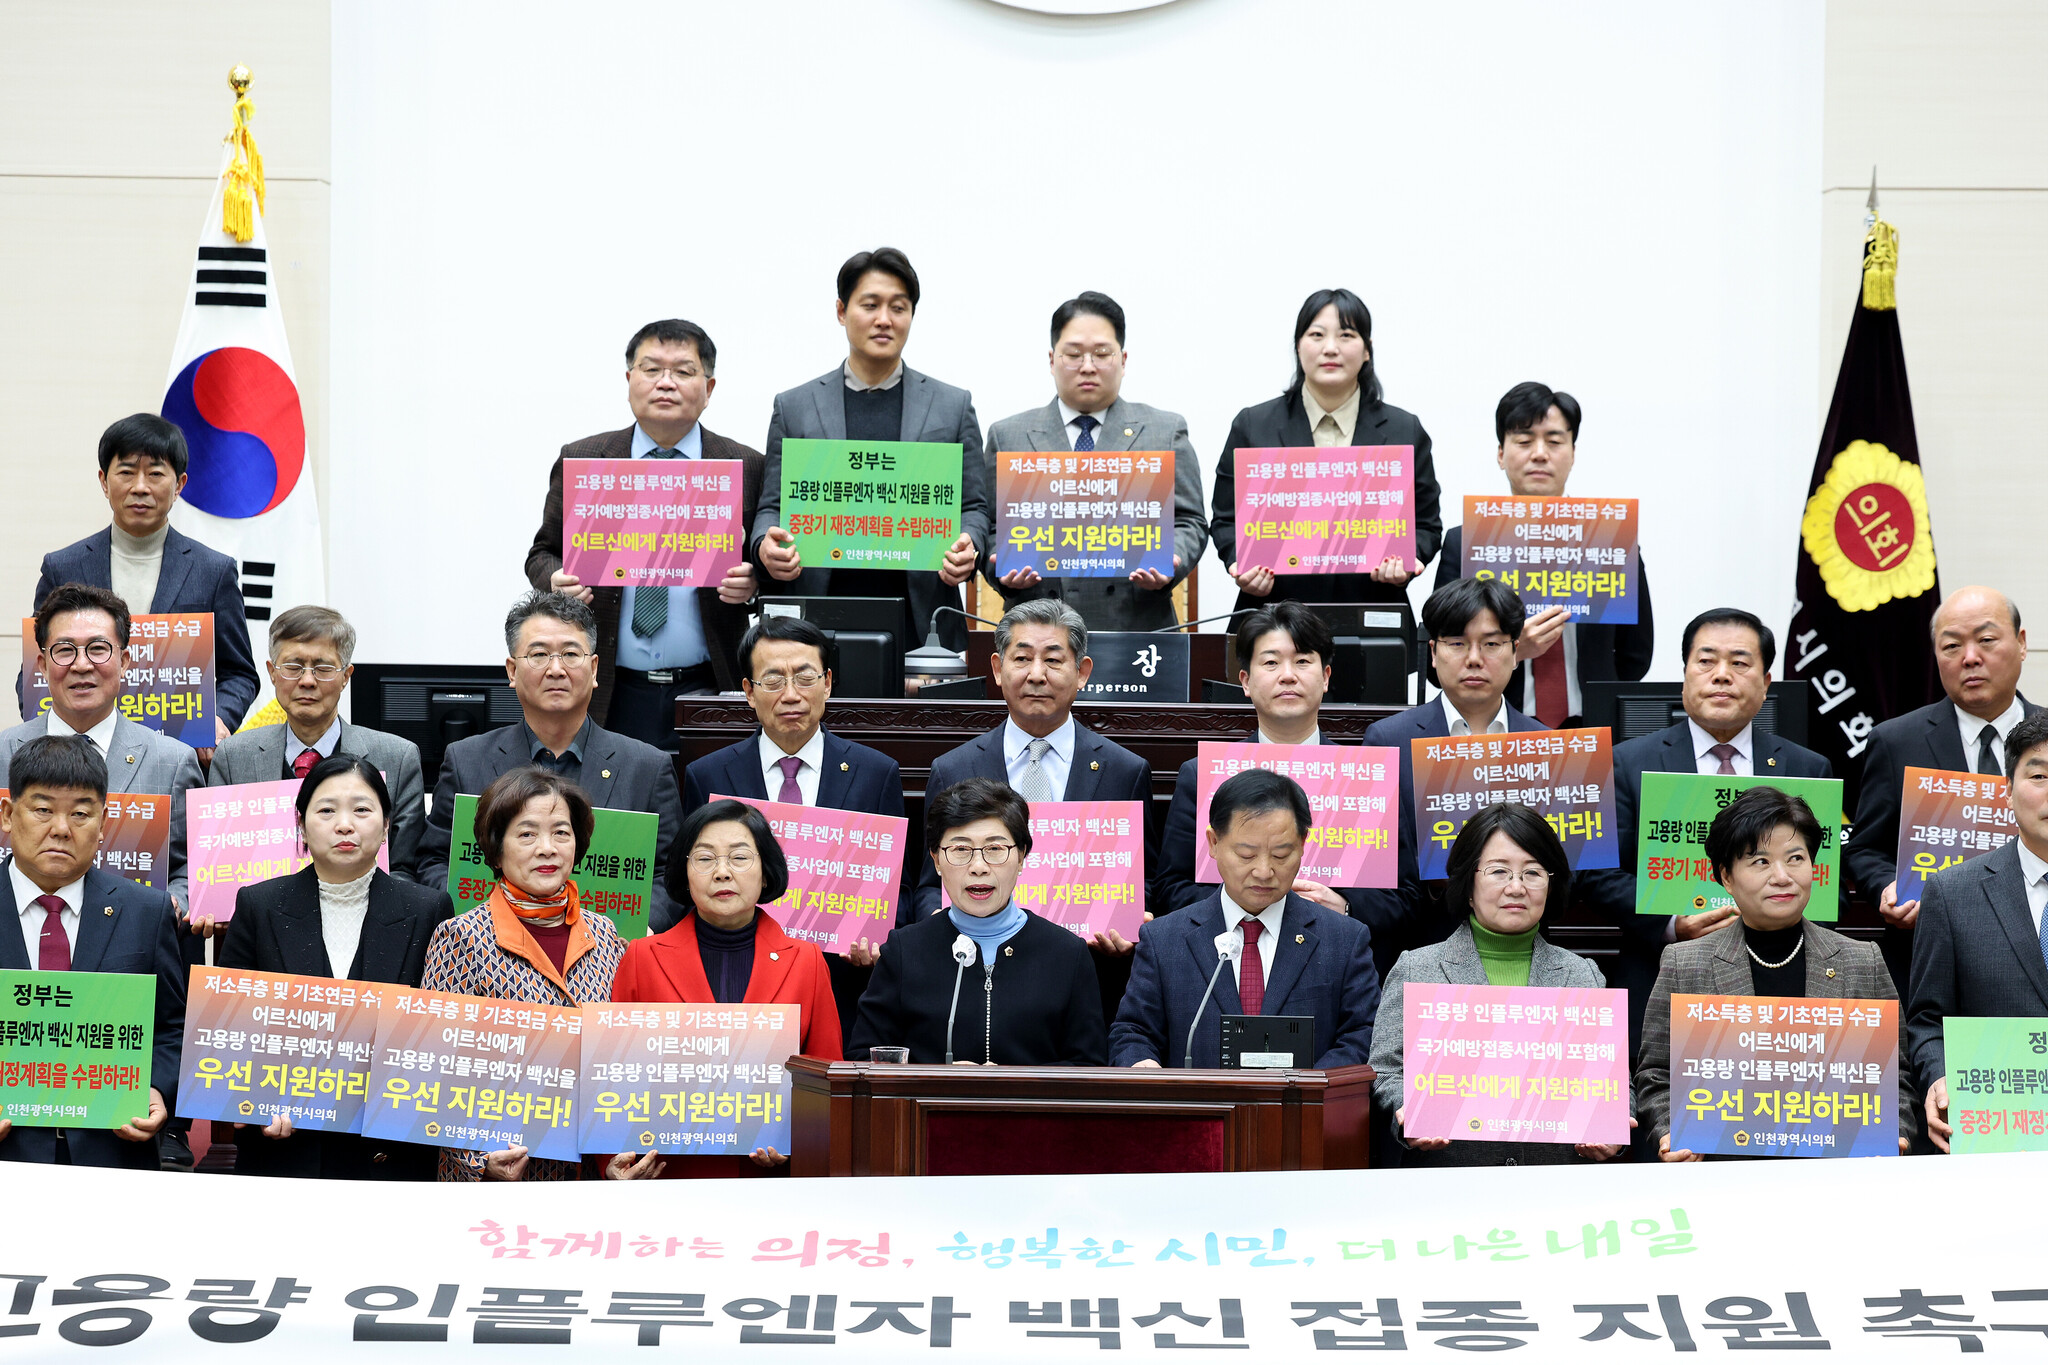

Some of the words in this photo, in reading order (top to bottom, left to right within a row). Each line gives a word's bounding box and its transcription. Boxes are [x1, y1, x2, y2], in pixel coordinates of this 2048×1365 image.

[848, 452, 896, 470] 정부는
[1010, 458, 1061, 473] 저소득층
[1065, 458, 1077, 473] 및
[1081, 458, 1132, 473] 기초연금
[1136, 458, 1161, 473] 수급
[1246, 463, 1286, 479] 고용량
[1291, 462, 1357, 478] 인플루엔자
[1362, 461, 1402, 477] 백신을
[575, 474, 615, 491] 고용량
[620, 475, 687, 491] 인플루엔자
[691, 475, 731, 491] 백신을
[789, 481, 820, 501] 고용량
[823, 482, 874, 503] 인플루엔자
[877, 483, 896, 504] 백신
[900, 483, 930, 504] 지원을
[933, 484, 953, 505] 위한
[1050, 479, 1117, 496] 어르신에게
[1006, 502, 1047, 519] 고용량
[1050, 501, 1118, 518] 인플루엔자
[1121, 501, 1161, 518] 백신을
[1246, 491, 1361, 507] 국가예방접종사업에
[1365, 490, 1403, 505] 포함해
[574, 504, 690, 519] 국가예방접종사업에
[693, 505, 732, 520] 포함해
[1475, 501, 1526, 518] 저소득층
[1530, 502, 1542, 518] 및
[1546, 503, 1598, 519] 기초연금
[1601, 504, 1627, 520] 수급
[789, 514, 827, 535] 중장기
[830, 515, 893, 537] 재정계획을
[897, 517, 951, 539] 수립하라!
[1244, 520, 1328, 540] 어르신에게
[1333, 518, 1406, 538] 지원하라!
[1515, 524, 1582, 541] 어르신에게
[1844, 495, 1909, 568] 의회
[572, 533, 656, 551] 어르신에게
[661, 533, 734, 552] 지원하라!
[1008, 525, 1054, 552] 우선
[1061, 525, 1161, 552] 지원하라!
[846, 549, 910, 561] 인천광역시의회
[1061, 559, 1125, 569] 인천광역시의회
[1302, 555, 1366, 566] 인천광역시의회
[1470, 546, 1512, 563] 고용량
[1515, 546, 1582, 564] 인플루엔자
[1585, 548, 1626, 565] 백신을
[629, 568, 693, 578] 인천광역시의회
[1525, 570, 1626, 598] 지원하라!
[173, 620, 201, 637] 수급
[1132, 644, 1162, 678] 장
[158, 667, 202, 685] 백신을
[115, 692, 202, 721] 원하라!
[1427, 742, 1484, 762] 저소득층
[1488, 741, 1502, 758] 및
[1507, 738, 1564, 757] 기초연금
[1568, 735, 1598, 754] 수급
[1341, 763, 1386, 781] 백신을
[1473, 761, 1550, 784] 어르신에게
[1426, 793, 1472, 812] 고용량
[1555, 784, 1600, 805] 백신을
[1918, 776, 1977, 798] 저소득층
[1981, 782, 1996, 800] 및
[126, 801, 155, 820] 수급
[198, 801, 243, 819] 고용량
[1342, 796, 1386, 813] 포함해
[770, 820, 844, 845] 인플루엔자
[849, 830, 894, 852] 백신을
[1086, 818, 1130, 836] 백신을
[1306, 827, 1388, 850] 지원하라!
[1647, 820, 1682, 843] 고용량
[1910, 825, 1957, 847] 고용량
[107, 850, 153, 871] 백신을
[585, 854, 620, 878] 지원을
[623, 857, 647, 880] 위한
[1088, 851, 1131, 867] 포함해
[1647, 856, 1689, 881] 중장기
[846, 863, 890, 884] 포함해
[806, 891, 889, 920] 지원하라!
[1053, 883, 1135, 905] 지원하라!
[13, 984, 73, 1008] 정부는
[205, 975, 269, 998] 저소득층
[274, 981, 289, 1000] 및
[293, 983, 356, 1007] 기초연금
[252, 1006, 336, 1032] 어르신에게
[395, 995, 459, 1020] 저소득층
[464, 1004, 480, 1023] 및
[484, 1006, 547, 1031] 기초연금
[551, 1014, 582, 1034] 수급
[598, 1010, 661, 1029] 저소득층
[665, 1011, 680, 1030] 및
[685, 1011, 748, 1030] 기초연금
[753, 1012, 784, 1030] 수급
[1418, 1002, 1468, 1022] 고용량
[1474, 1004, 1558, 1025] 인플루엔자
[1563, 1007, 1614, 1027] 백신을
[1687, 1003, 1753, 1023] 저소득층
[1757, 1005, 1773, 1025] 및
[1779, 1005, 1844, 1026] 기초연금
[1848, 1007, 1881, 1028] 수급
[49, 1022, 73, 1048] 백신
[76, 1022, 115, 1050] 지원을
[118, 1025, 143, 1050] 위한
[194, 1028, 246, 1051] 고용량
[250, 1033, 333, 1059] 인플루엔자
[442, 1027, 526, 1056] 어르신에게
[647, 1036, 730, 1056] 어르신에게
[1739, 1031, 1825, 1054] 어르신에게
[1417, 1038, 1562, 1061] 국가예방접종사업에
[1567, 1043, 1615, 1062] 포함해
[72, 1064, 140, 1091] 수립하라!
[194, 1057, 253, 1092] 우선
[383, 1048, 436, 1072] 고용량
[439, 1054, 522, 1083] 인플루엔자
[526, 1065, 576, 1090] 백신을
[591, 1063, 642, 1083] 고용량
[646, 1063, 729, 1083] 인플루엔자
[733, 1064, 783, 1084] 백신을
[1682, 1058, 1734, 1080] 고용량
[1738, 1060, 1825, 1083] 인플루엔자
[1830, 1062, 1881, 1084] 백신을
[1414, 1073, 1520, 1100] 어르신에게
[1526, 1077, 1619, 1102] 지원하라!
[1956, 1068, 1995, 1094] 고용량
[7, 1103, 87, 1118] 인천광역시의회
[382, 1077, 441, 1113] 우선
[447, 1085, 573, 1128] 지원하라!
[594, 1091, 650, 1123] 우선
[658, 1092, 783, 1124] 지원하라!
[1685, 1088, 1744, 1121] 우선
[1753, 1090, 1881, 1126] 지원하라!
[1487, 1119, 1568, 1133] 인천광역시의회
[1960, 1109, 2008, 1135] 중장기
[445, 1125, 523, 1145] 인천광역시의회
[659, 1132, 738, 1146] 인천광역시의회
[1754, 1132, 1835, 1147] 인천광역시의회
[468, 1218, 725, 1261] 함께하는
[751, 1229, 914, 1269] 의정,
[936, 1226, 1136, 1269] 행복한
[1155, 1227, 1316, 1268] 시민,
[1336, 1237, 1397, 1262] 더
[1416, 1227, 1531, 1262] 나은
[1545, 1207, 1700, 1261] 내일
[344, 1283, 972, 1349] 인플루엔자
[1008, 1296, 1250, 1351] 백신
[1290, 1296, 1540, 1352] 접종
[1572, 1291, 1832, 1352] 지원
